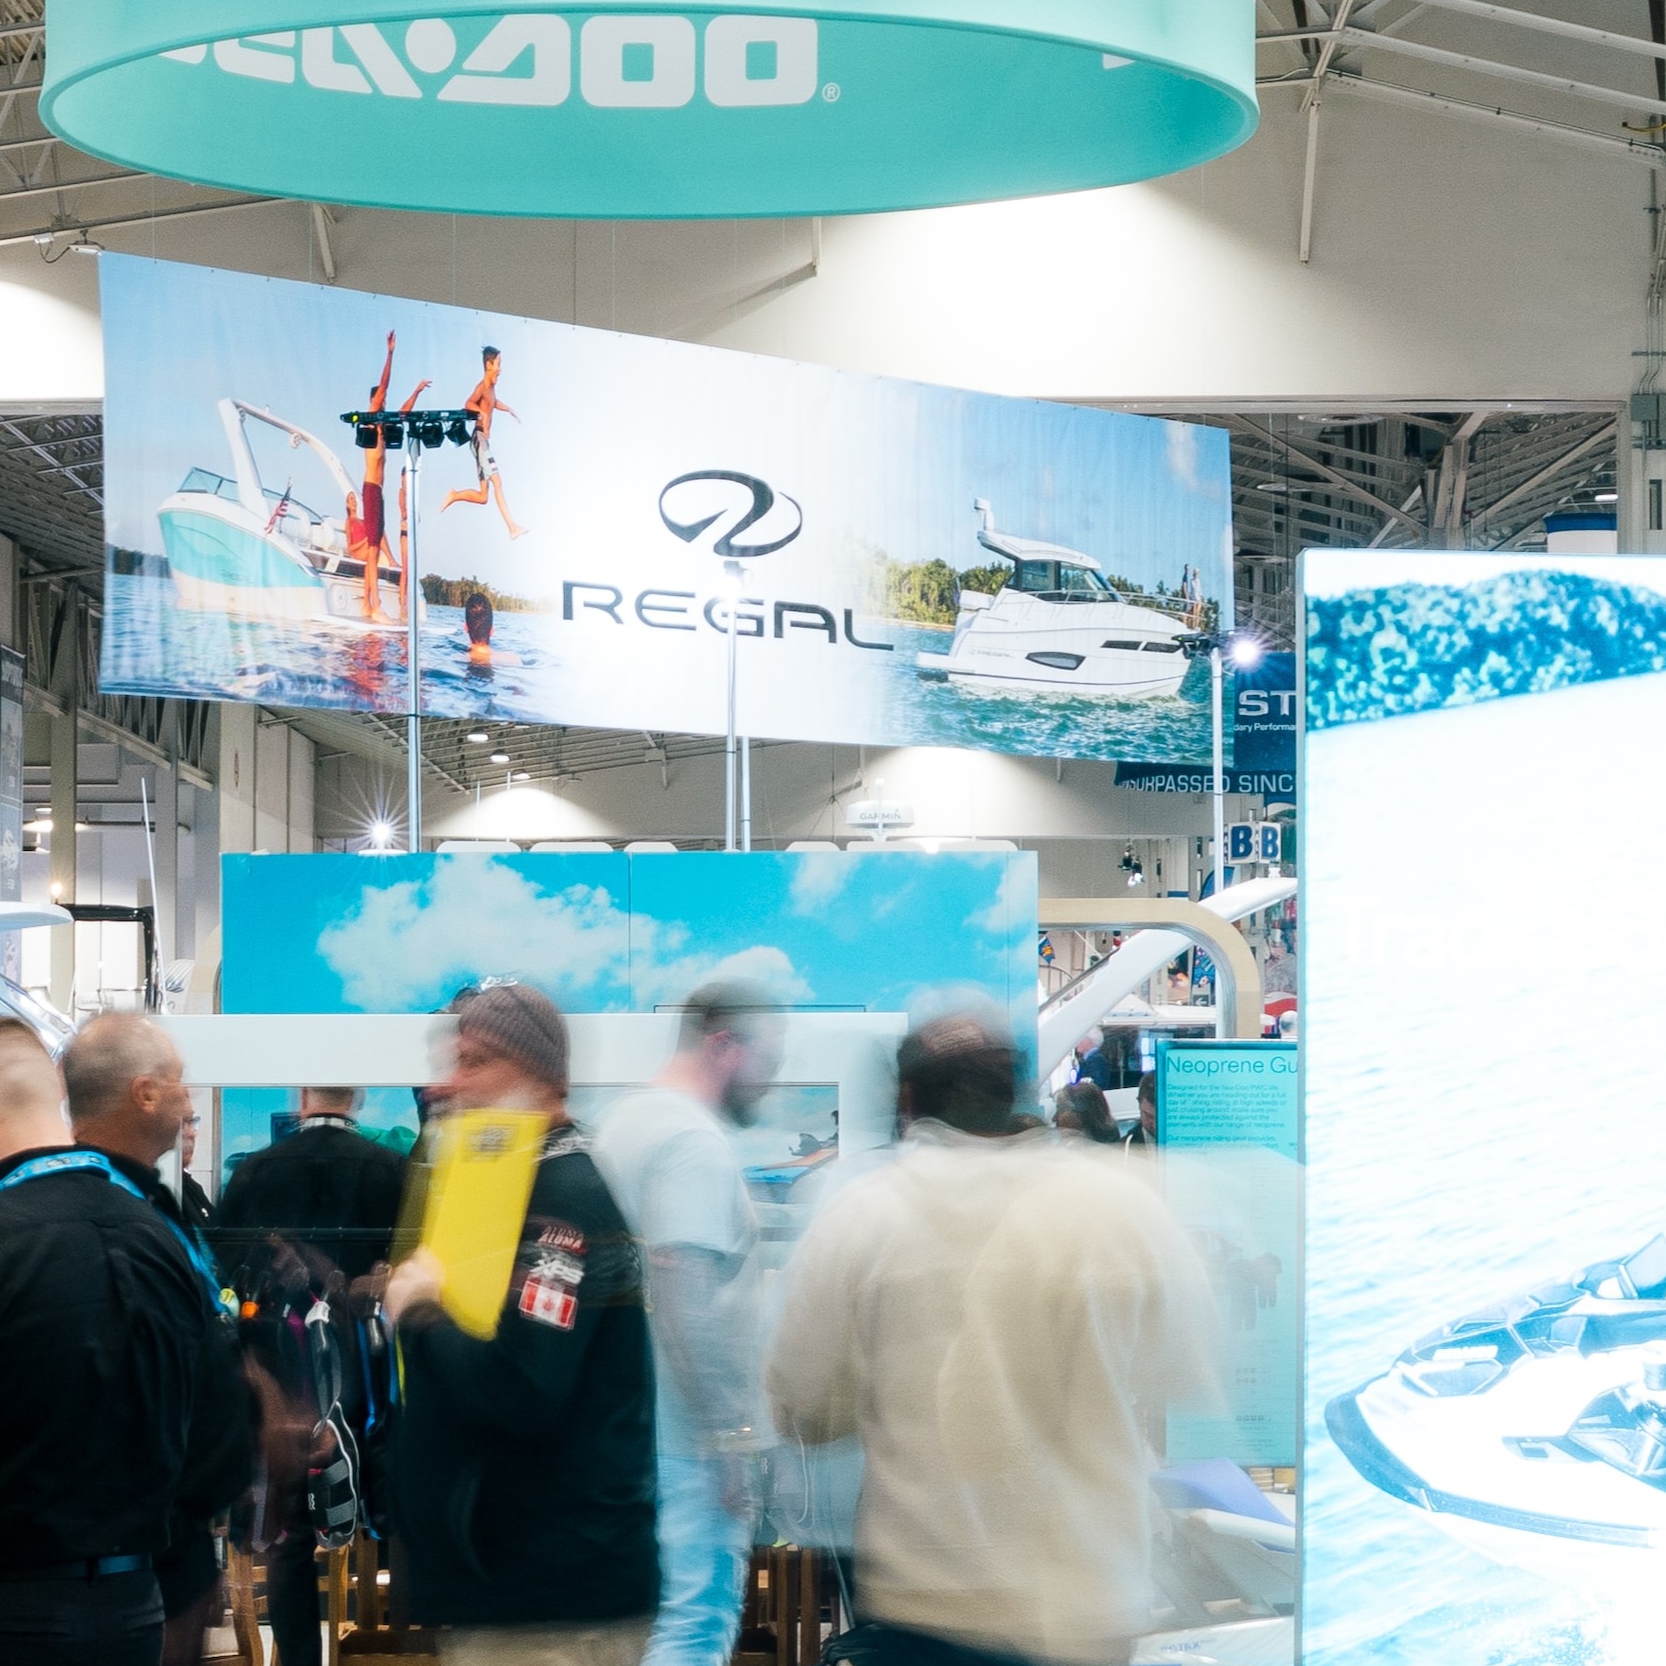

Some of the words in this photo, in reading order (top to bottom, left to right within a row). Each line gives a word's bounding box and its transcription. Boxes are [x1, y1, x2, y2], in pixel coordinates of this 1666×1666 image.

[562, 580, 895, 652] REGAL
[1230, 825, 1253, 861] B
[1261, 824, 1279, 860] B
[1166, 1056, 1264, 1077] Neoprene
